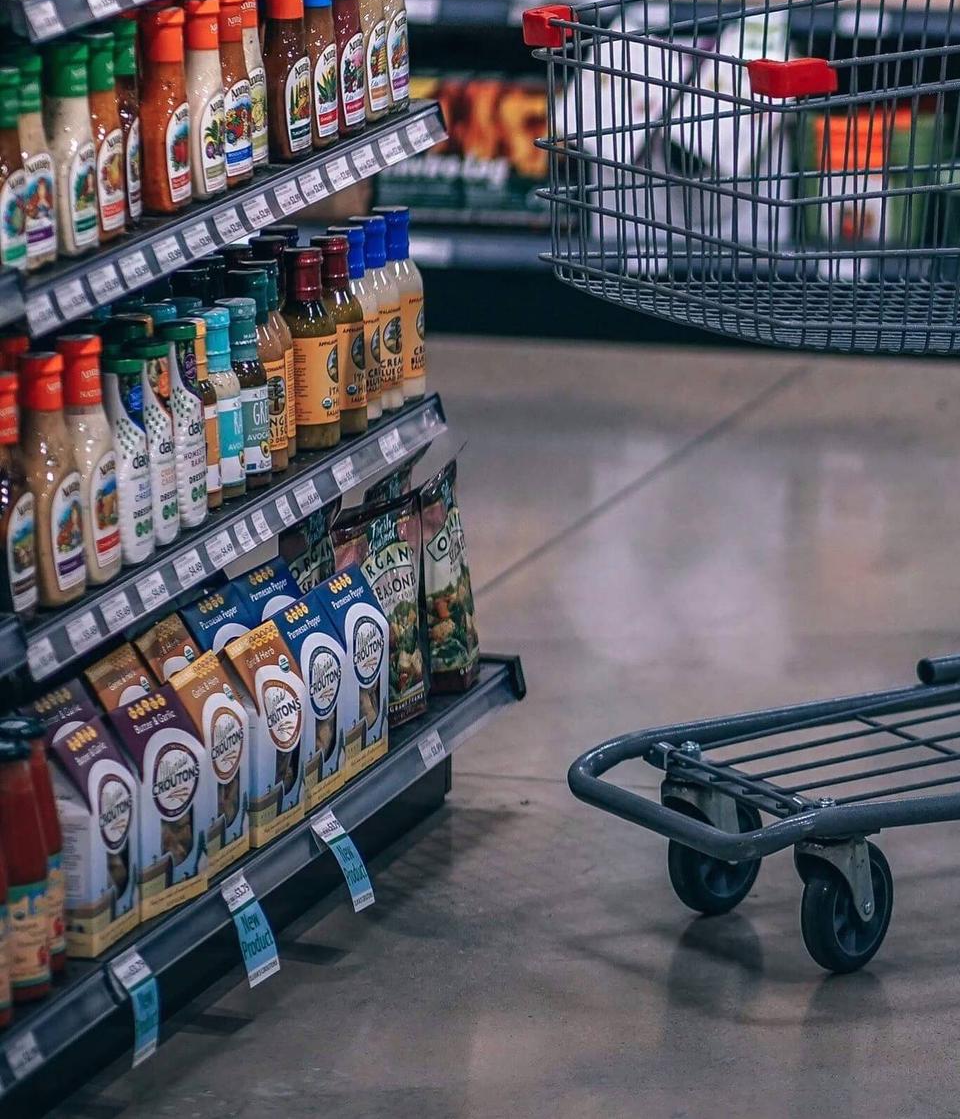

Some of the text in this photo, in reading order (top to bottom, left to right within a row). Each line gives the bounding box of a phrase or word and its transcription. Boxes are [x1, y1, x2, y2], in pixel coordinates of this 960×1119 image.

[152, 762, 200, 796] CROUTONS
[240, 912, 261, 934] New
[241, 929, 275, 961] Product
